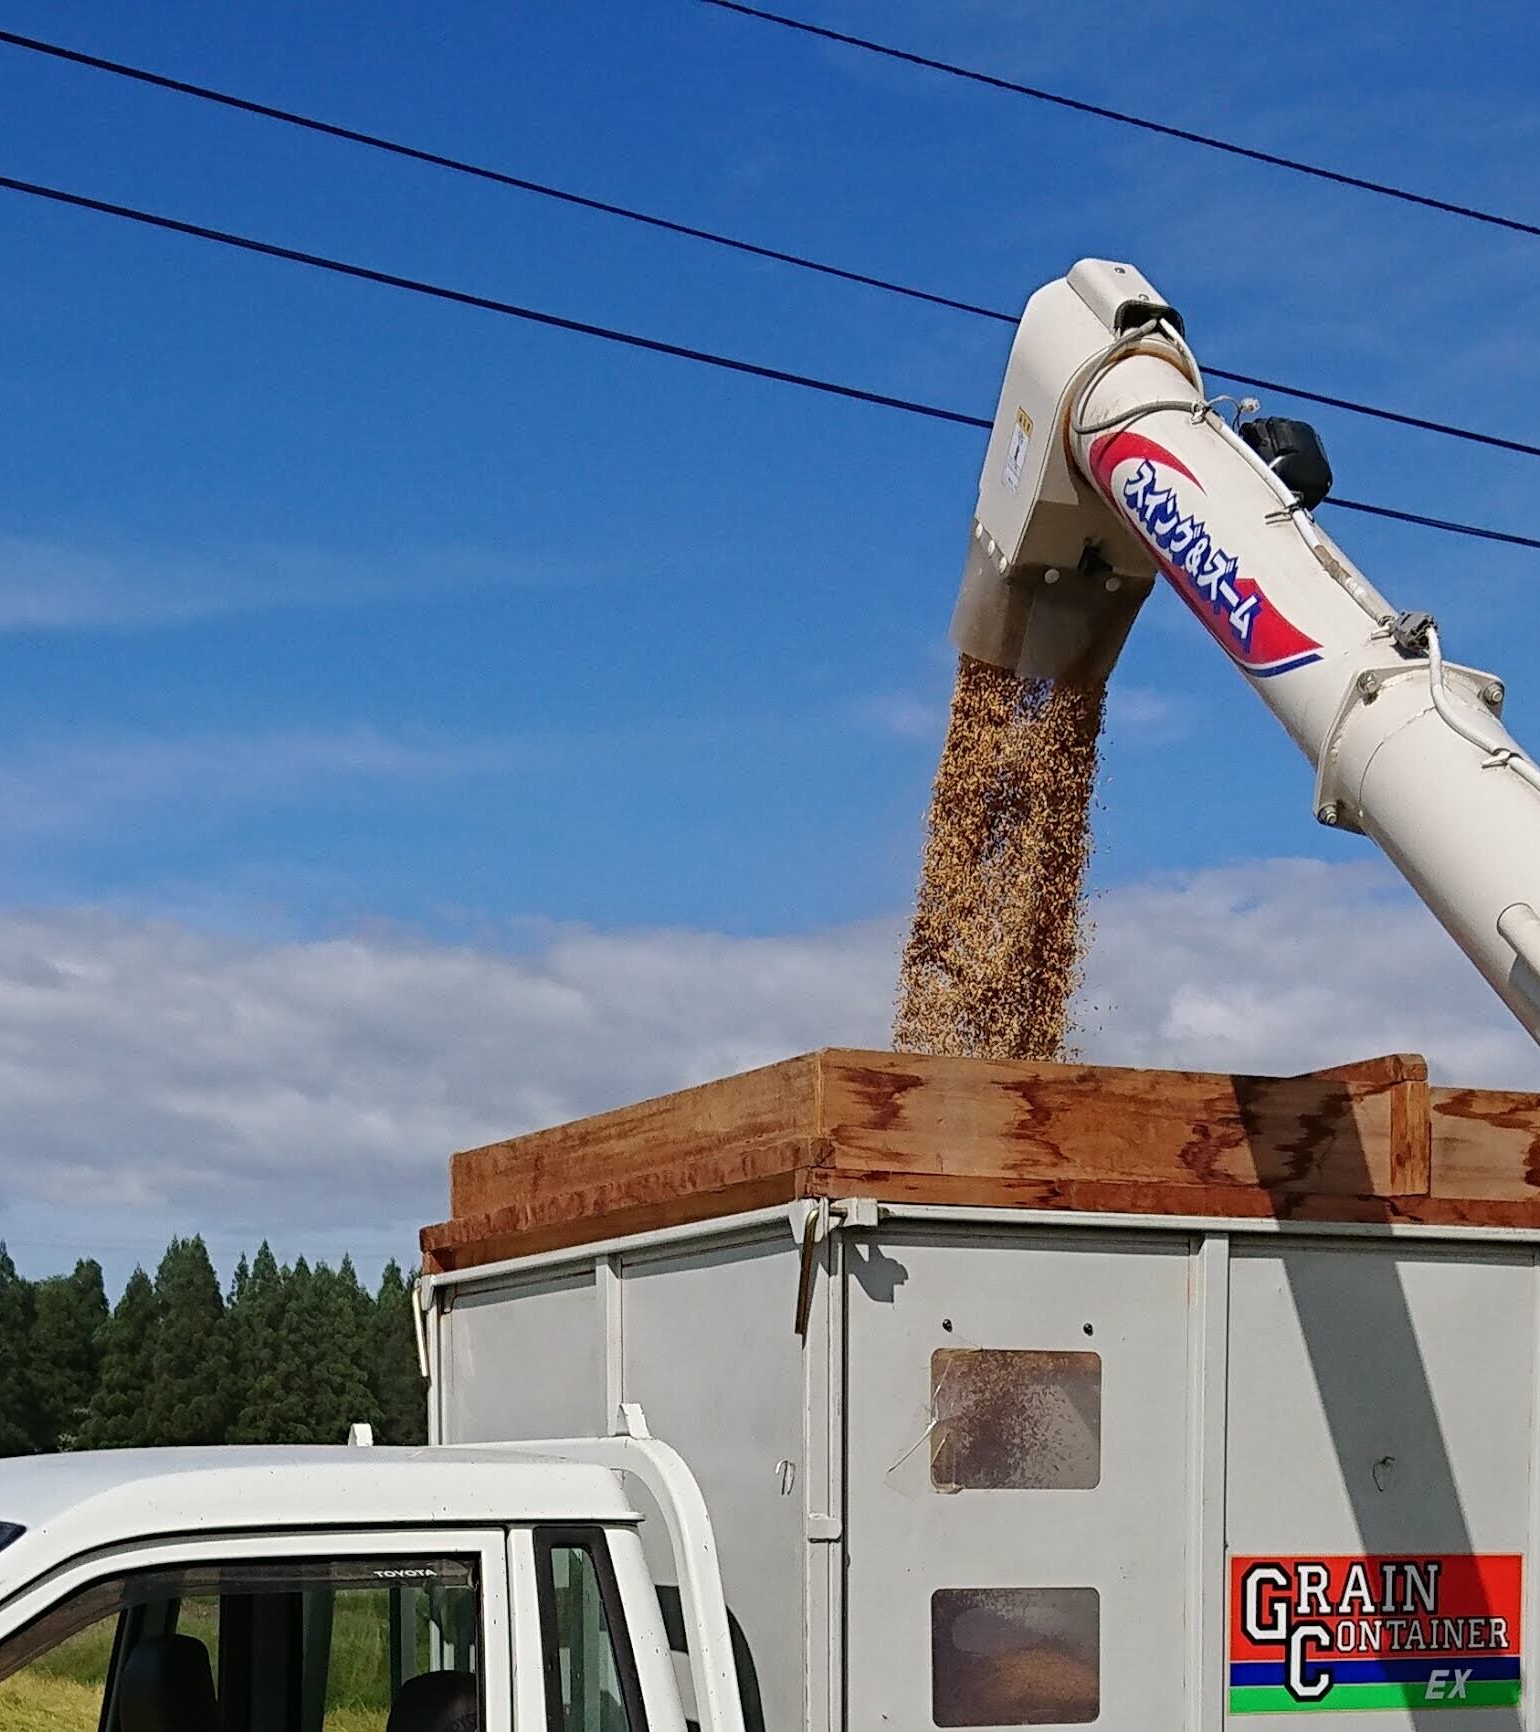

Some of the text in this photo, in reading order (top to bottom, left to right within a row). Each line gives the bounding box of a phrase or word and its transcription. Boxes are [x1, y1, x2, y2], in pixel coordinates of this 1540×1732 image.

[372, 1568, 438, 1578] TOYOTA
[1244, 1563, 1440, 1641] GRAIN
[1289, 1617, 1510, 1698] CONTAINER
[1425, 1669, 1472, 1700] EX
